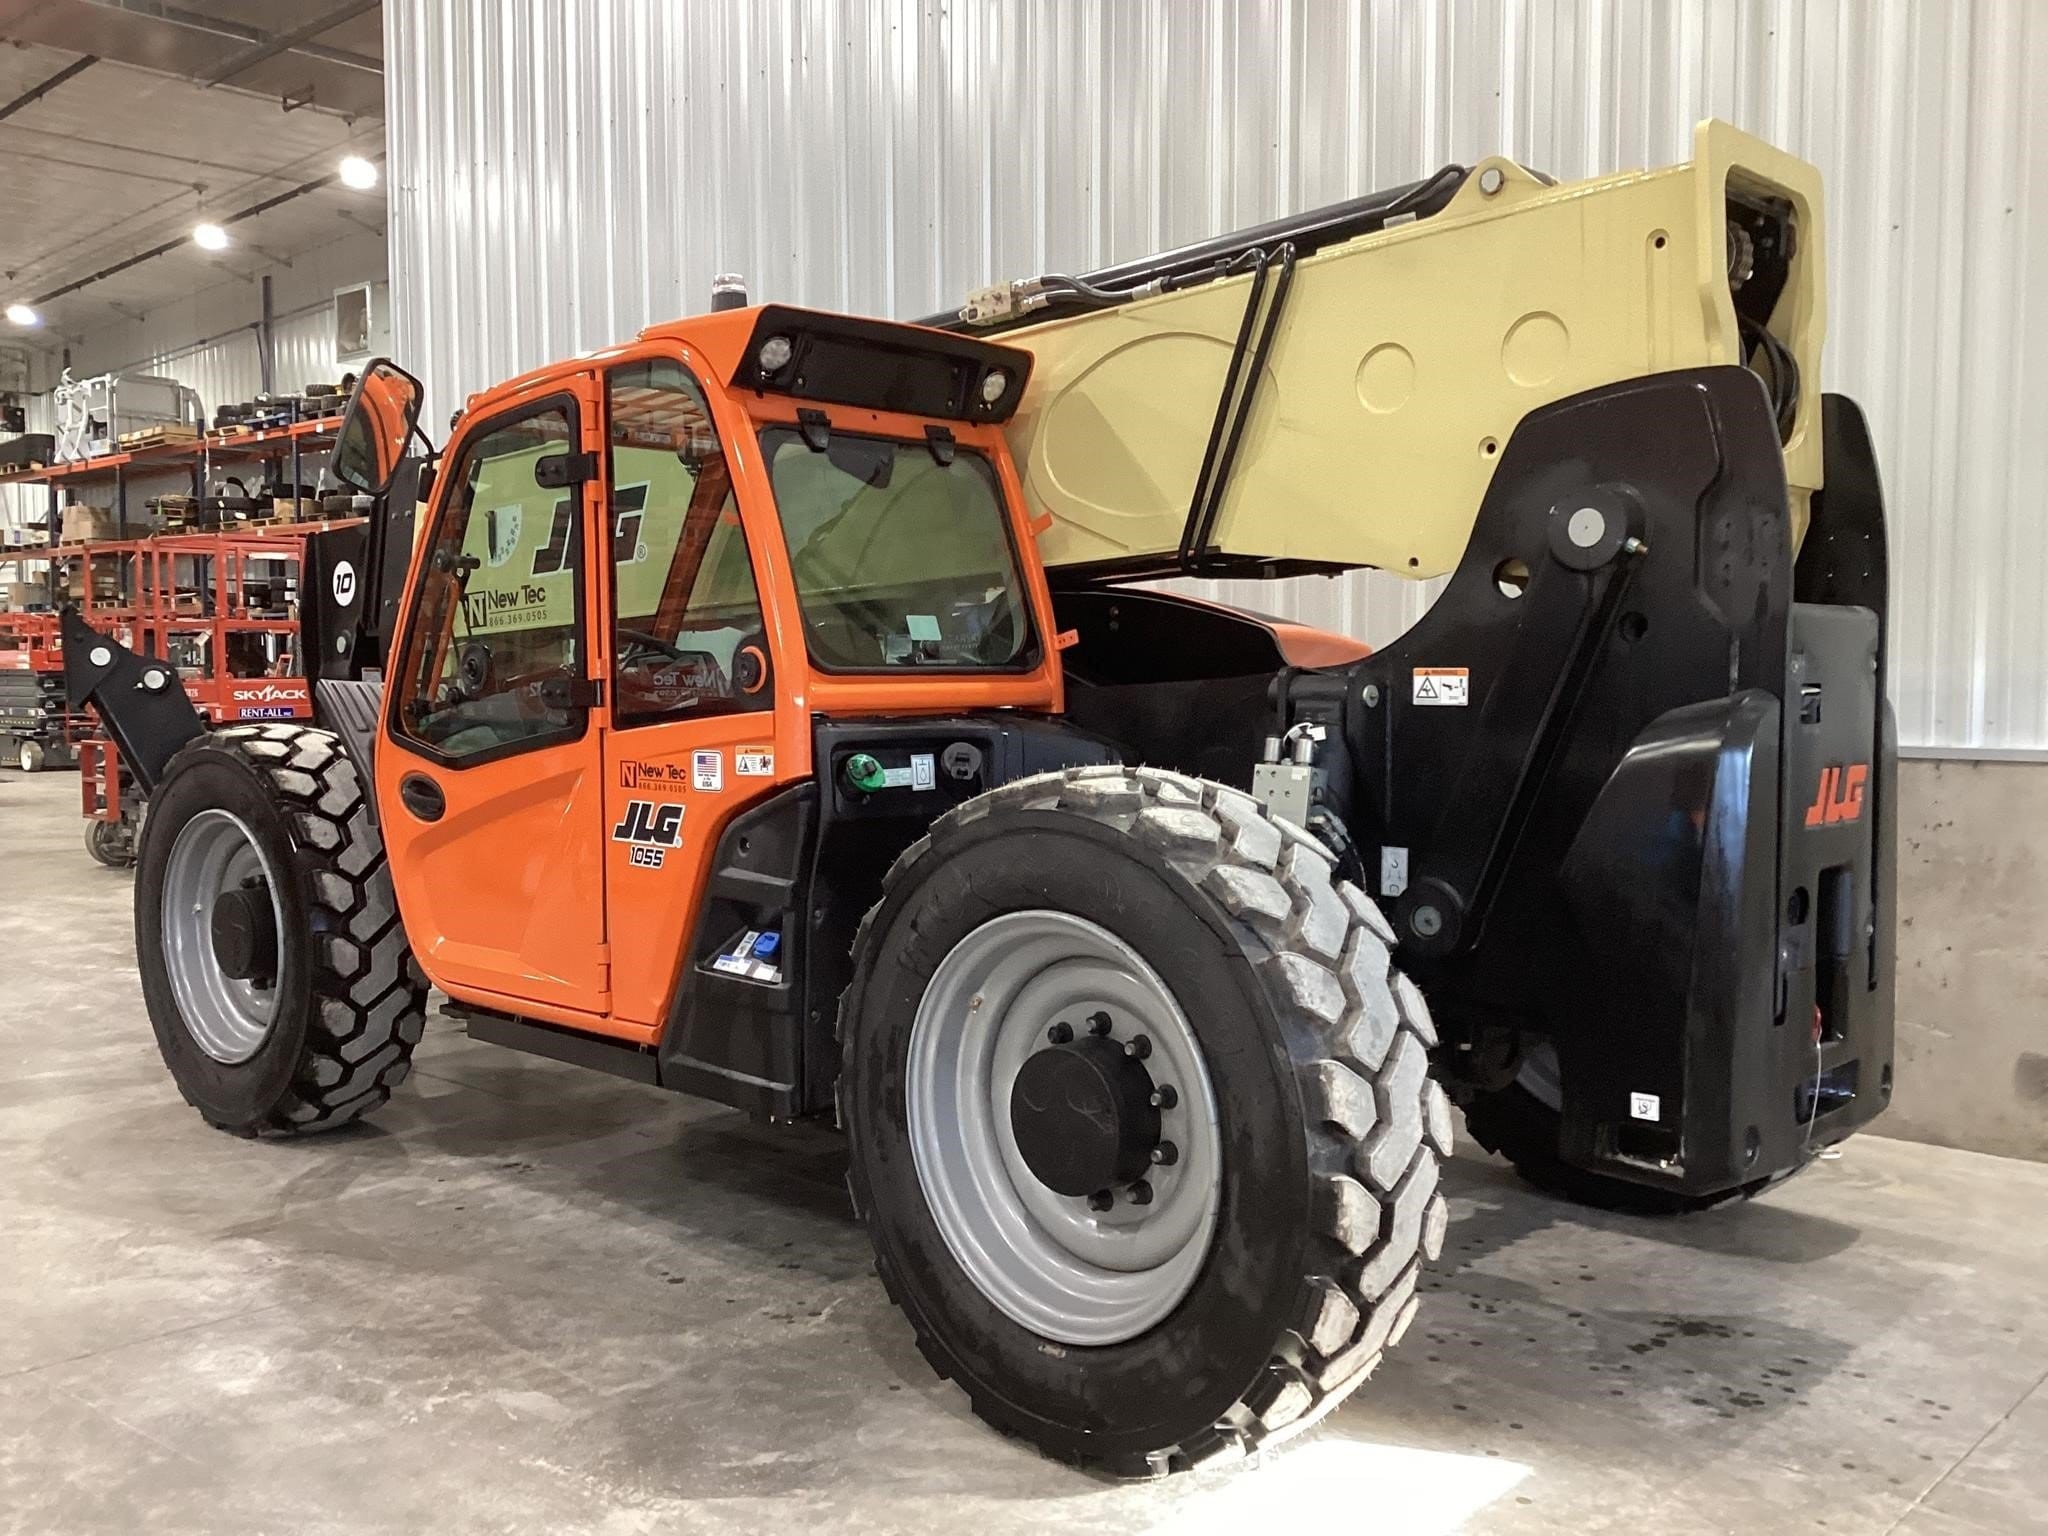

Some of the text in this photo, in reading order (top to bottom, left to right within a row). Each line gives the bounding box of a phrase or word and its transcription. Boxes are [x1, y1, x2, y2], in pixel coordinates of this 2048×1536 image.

[531, 485, 649, 575] JG
[336, 573, 352, 594] 10
[488, 584, 546, 609] New Tec
[489, 609, 547, 627] 866.369.0505
[233, 685, 307, 702] SKYJACK
[241, 708, 281, 718] RENT-ALL
[638, 762, 687, 780] New Tec
[1805, 764, 1867, 826] JLG
[614, 802, 684, 845] JLG
[630, 846, 664, 867] 1055
